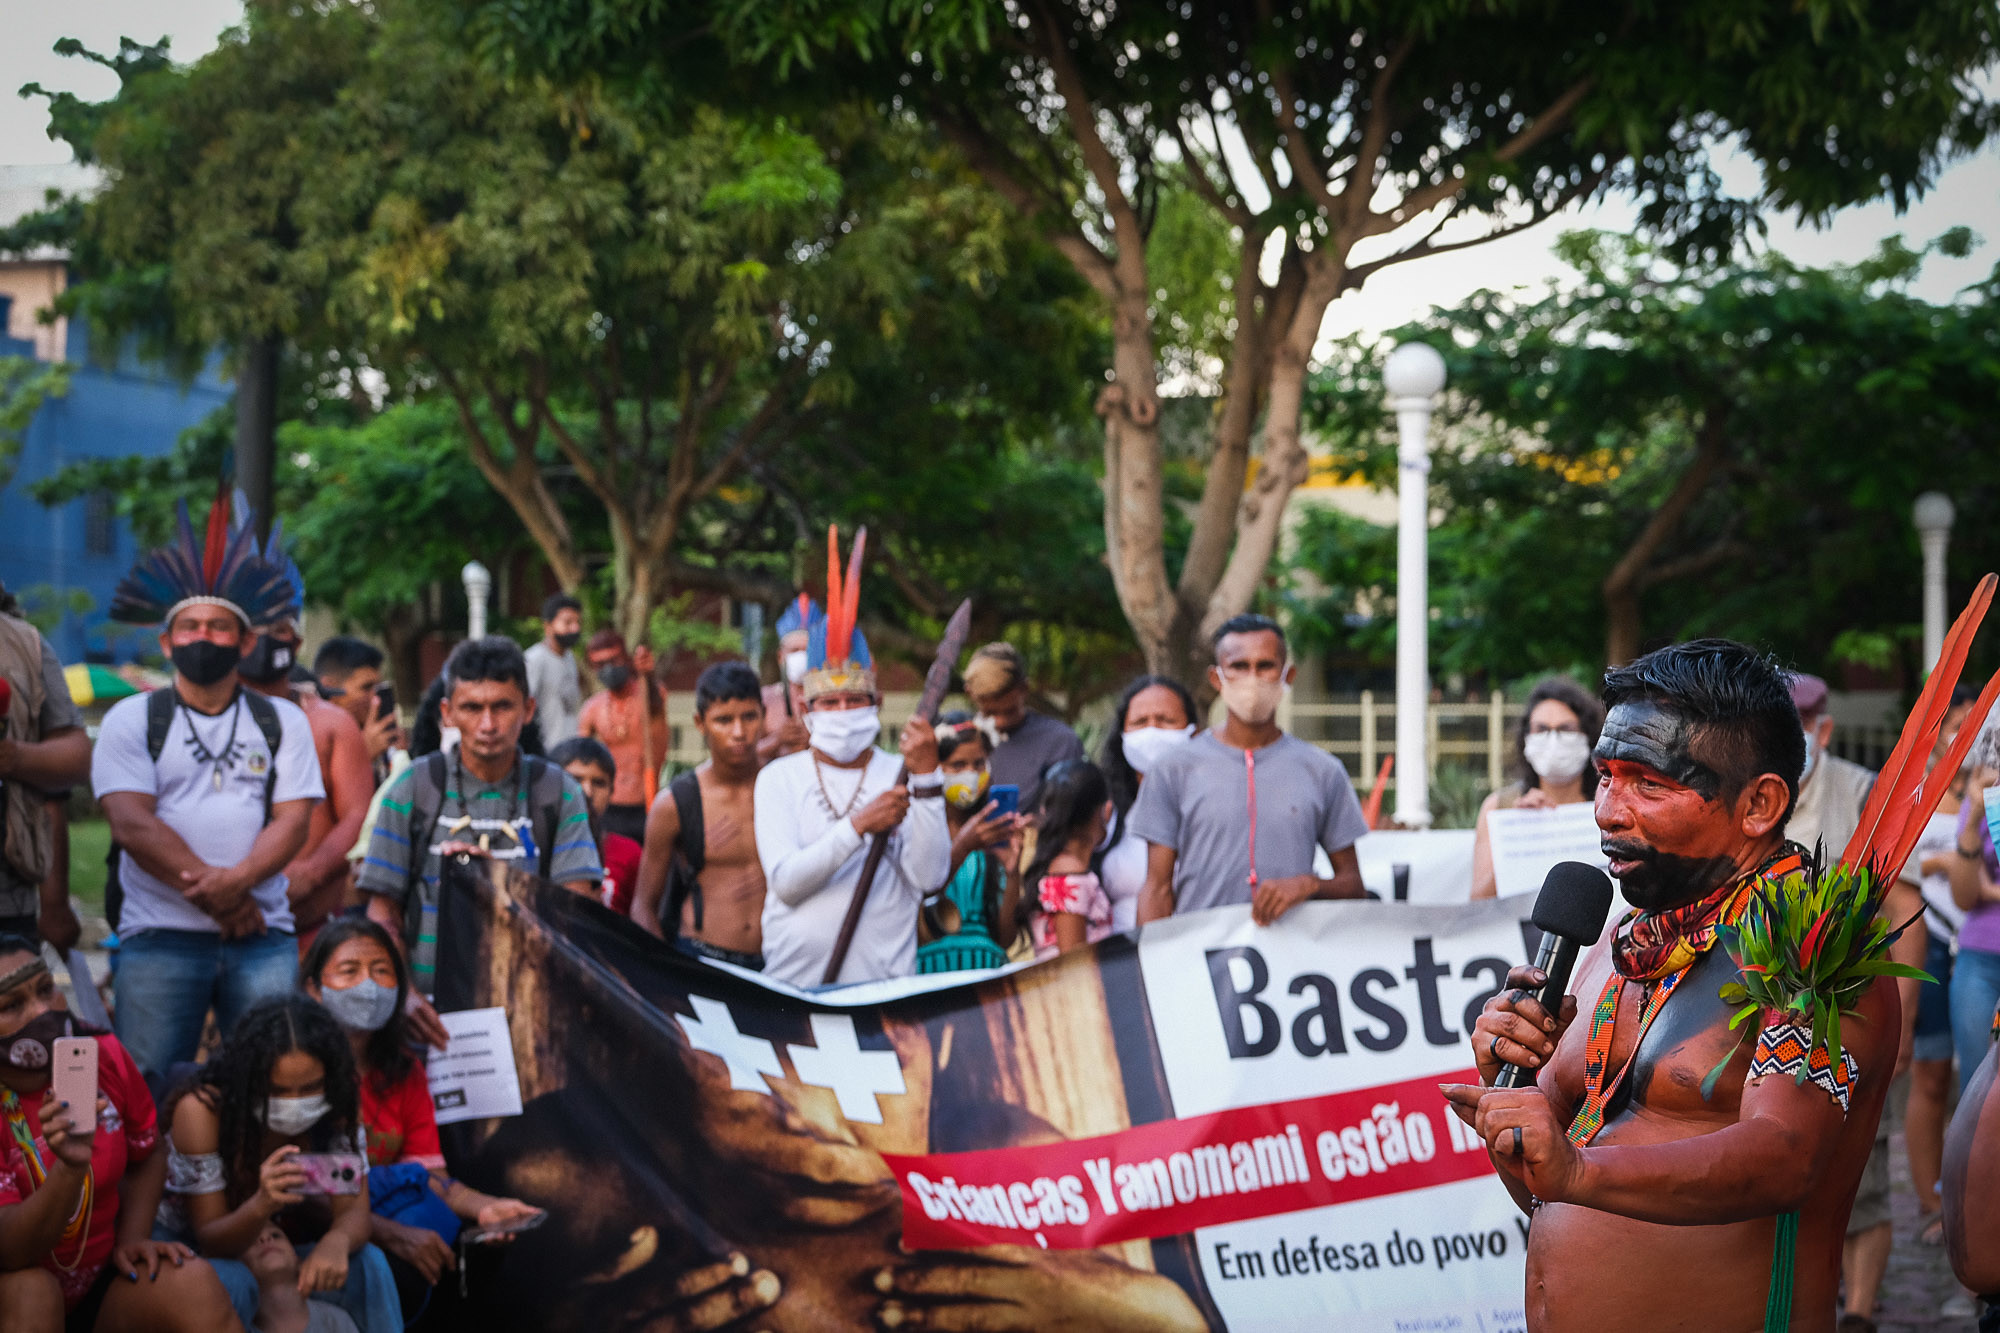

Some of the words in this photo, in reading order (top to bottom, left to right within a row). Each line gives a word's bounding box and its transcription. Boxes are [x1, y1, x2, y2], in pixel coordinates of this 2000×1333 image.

[908, 1172, 1091, 1250] Crianças
[1082, 1124, 1311, 1216] Yanomami
[1316, 1101, 1437, 1182] estão
[1214, 1242, 1267, 1280] Em
[1272, 1235, 1381, 1277] defesa
[1386, 1229, 1425, 1268] do
[1432, 1230, 1508, 1270] povo
